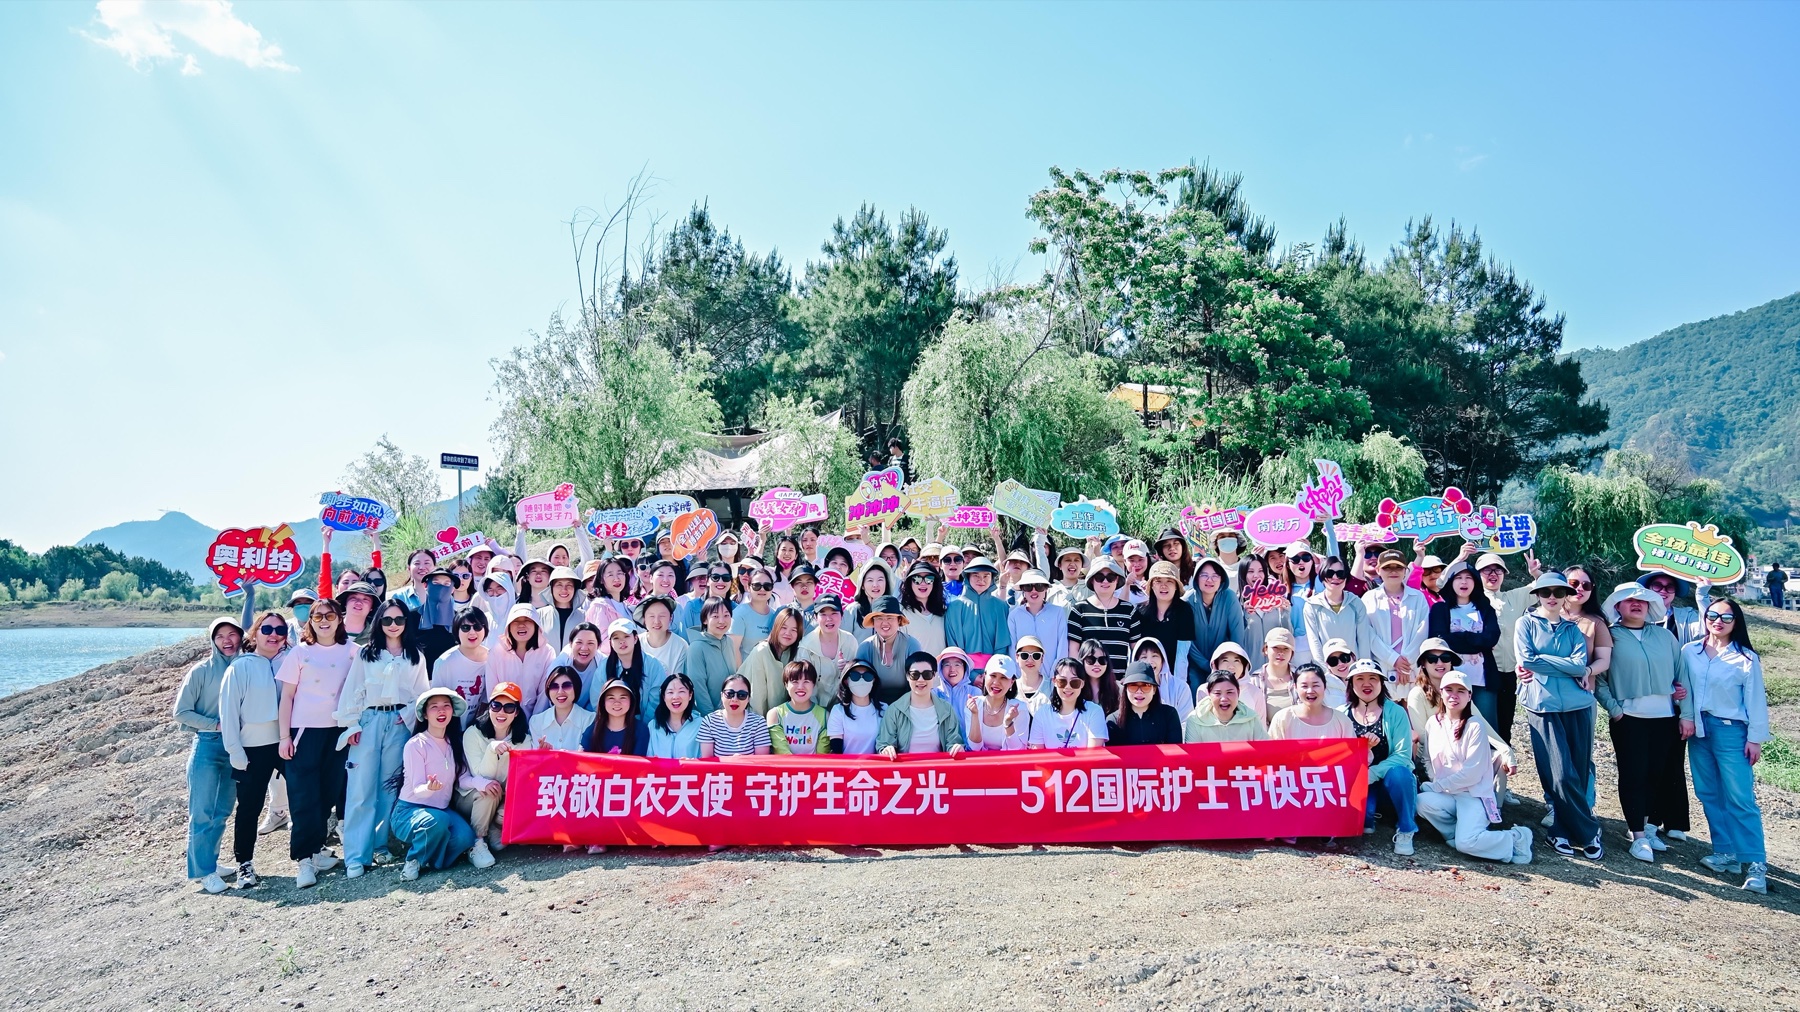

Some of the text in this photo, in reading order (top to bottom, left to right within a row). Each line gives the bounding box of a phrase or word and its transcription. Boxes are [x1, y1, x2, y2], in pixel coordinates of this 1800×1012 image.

[903, 481, 933, 496] 社交
[320, 493, 382, 516] 脚步如风
[524, 503, 563, 513] 随时随地
[643, 501, 692, 514] 我撑腰
[848, 495, 900, 521] 冲冲冲
[322, 506, 381, 530] 向前冲锋
[525, 512, 573, 522] 充满女子力
[1072, 511, 1095, 521] 工作
[1397, 506, 1456, 531] 你能行
[1498, 515, 1531, 532] 上班
[1061, 520, 1106, 532] 使我快乐
[1257, 517, 1301, 533] 南波万
[1335, 524, 1363, 533] 公主
[1500, 531, 1533, 548] 搭子
[1643, 532, 1732, 567] 全场最佳
[212, 544, 294, 572] 奥利给
[819, 575, 843, 591] 今天
[1243, 579, 1287, 600] Hello
[786, 725, 811, 734] Hello
[785, 735, 812, 745] World
[536, 765, 1347, 818] 致敬白衣天使 守护生命之光——512国际护士节快乐!
